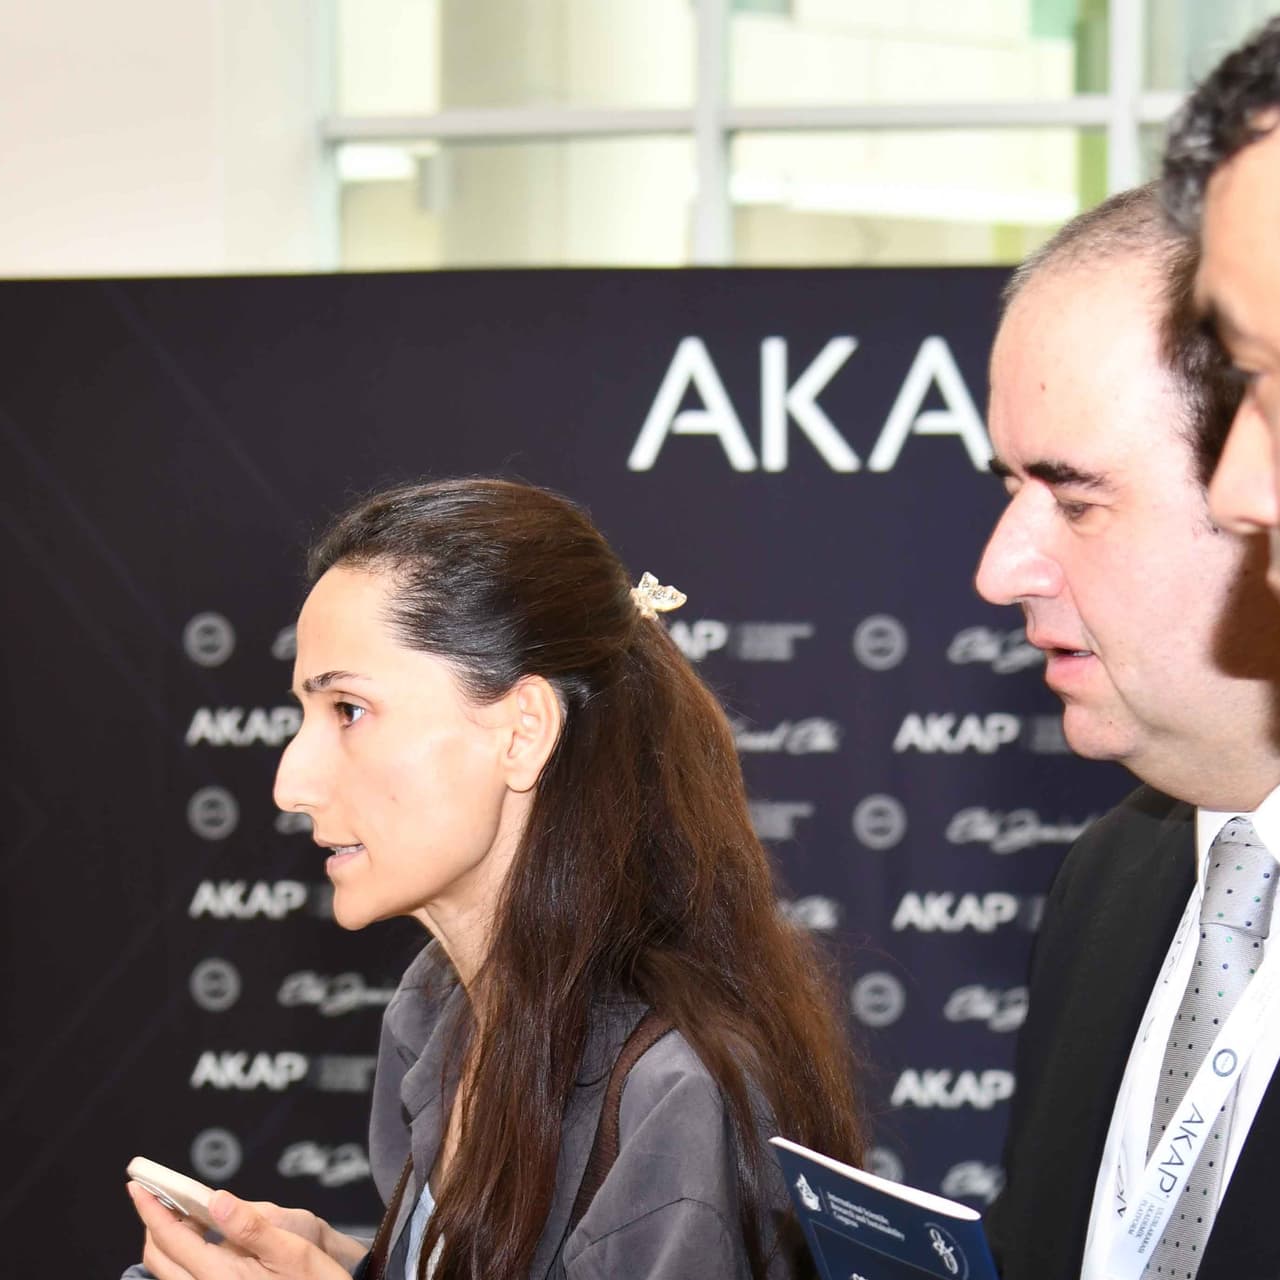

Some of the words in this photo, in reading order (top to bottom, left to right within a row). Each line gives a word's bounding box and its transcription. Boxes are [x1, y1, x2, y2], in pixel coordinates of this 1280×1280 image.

[892, 711, 1022, 755] AKAP
[188, 878, 309, 920] AKAP
[892, 890, 1019, 933] AKAP
[190, 1050, 310, 1092] AKAP
[890, 1068, 1017, 1110] AKAP
[1157, 1102, 1205, 1194] AKAP
